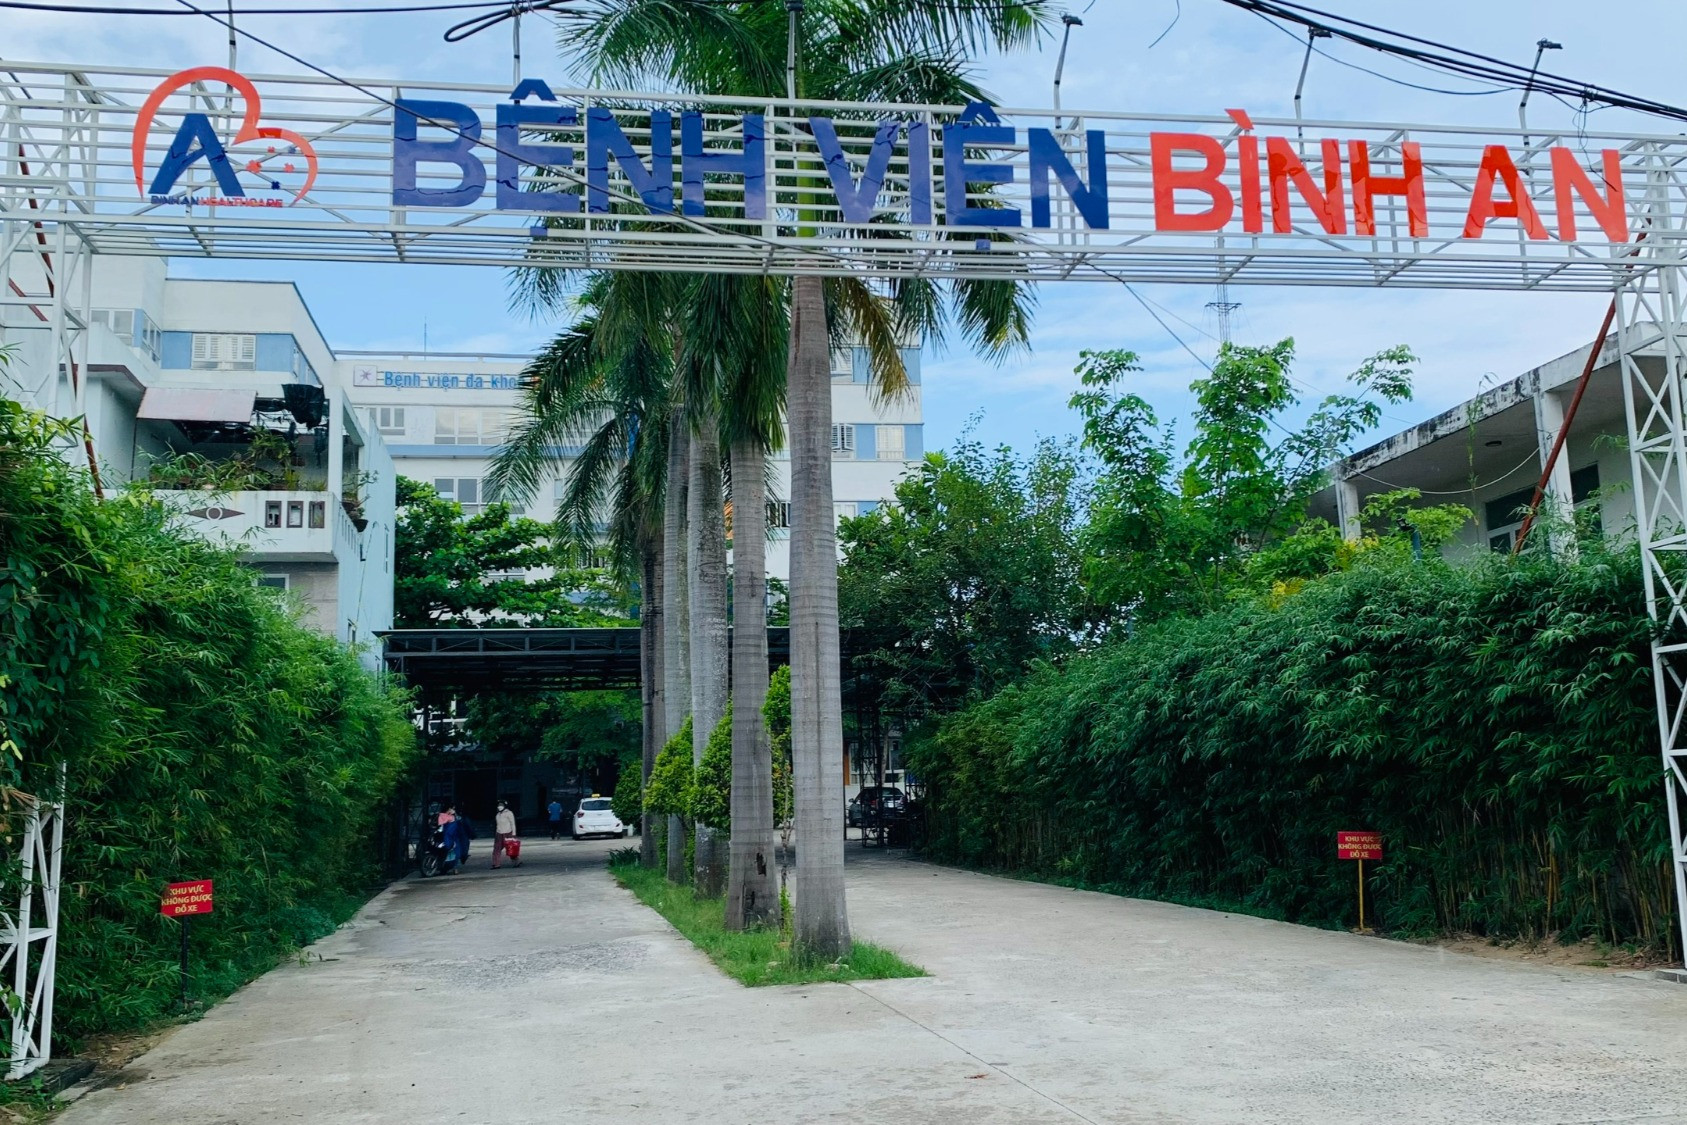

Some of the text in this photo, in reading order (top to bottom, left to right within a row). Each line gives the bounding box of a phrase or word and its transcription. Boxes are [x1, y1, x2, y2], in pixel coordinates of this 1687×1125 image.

[393, 78, 1629, 250] BỆNH VIỆN BÌNH AN
[466, 374, 484, 389] đa
[161, 896, 190, 906] KHÔNG
[188, 904, 198, 912] XE
